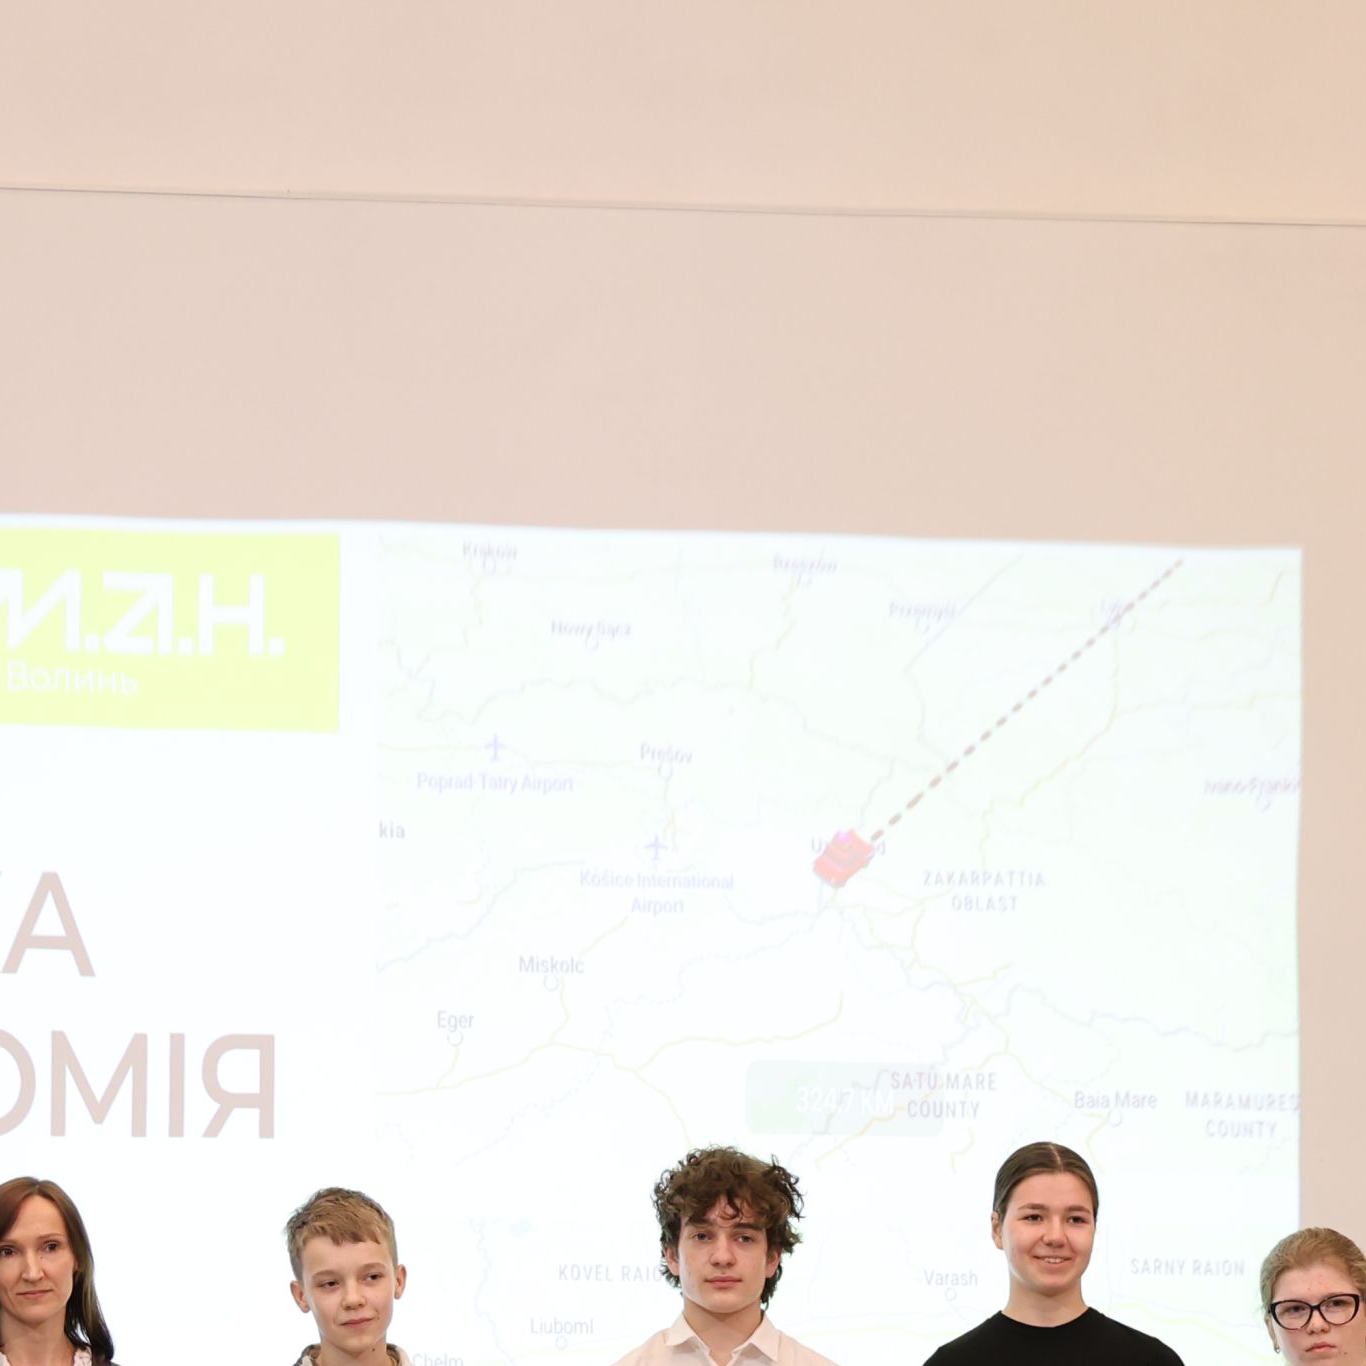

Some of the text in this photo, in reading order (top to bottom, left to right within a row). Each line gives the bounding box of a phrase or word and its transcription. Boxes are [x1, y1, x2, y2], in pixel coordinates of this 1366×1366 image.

[5, 660, 139, 698] Волинь
[521, 774, 574, 795] Airport
[636, 870, 735, 890] International
[922, 870, 1045, 887] ZAKARPATTIA
[630, 896, 685, 920] Airport
[950, 895, 1018, 912] OBLAST
[518, 955, 584, 974] Miskolc
[436, 1010, 475, 1032] Eger
[889, 1071, 997, 1091] SATU MARE
[905, 1100, 981, 1119] COUNTY
[1074, 1090, 1158, 1110] Baia Mare
[1205, 1119, 1277, 1138] COUNTY
[557, 1263, 661, 1283] KOVEL RAIO
[1130, 1258, 1246, 1277] SARNY RAION
[923, 1269, 978, 1287] Varash
[530, 1317, 595, 1335] Liuboml
